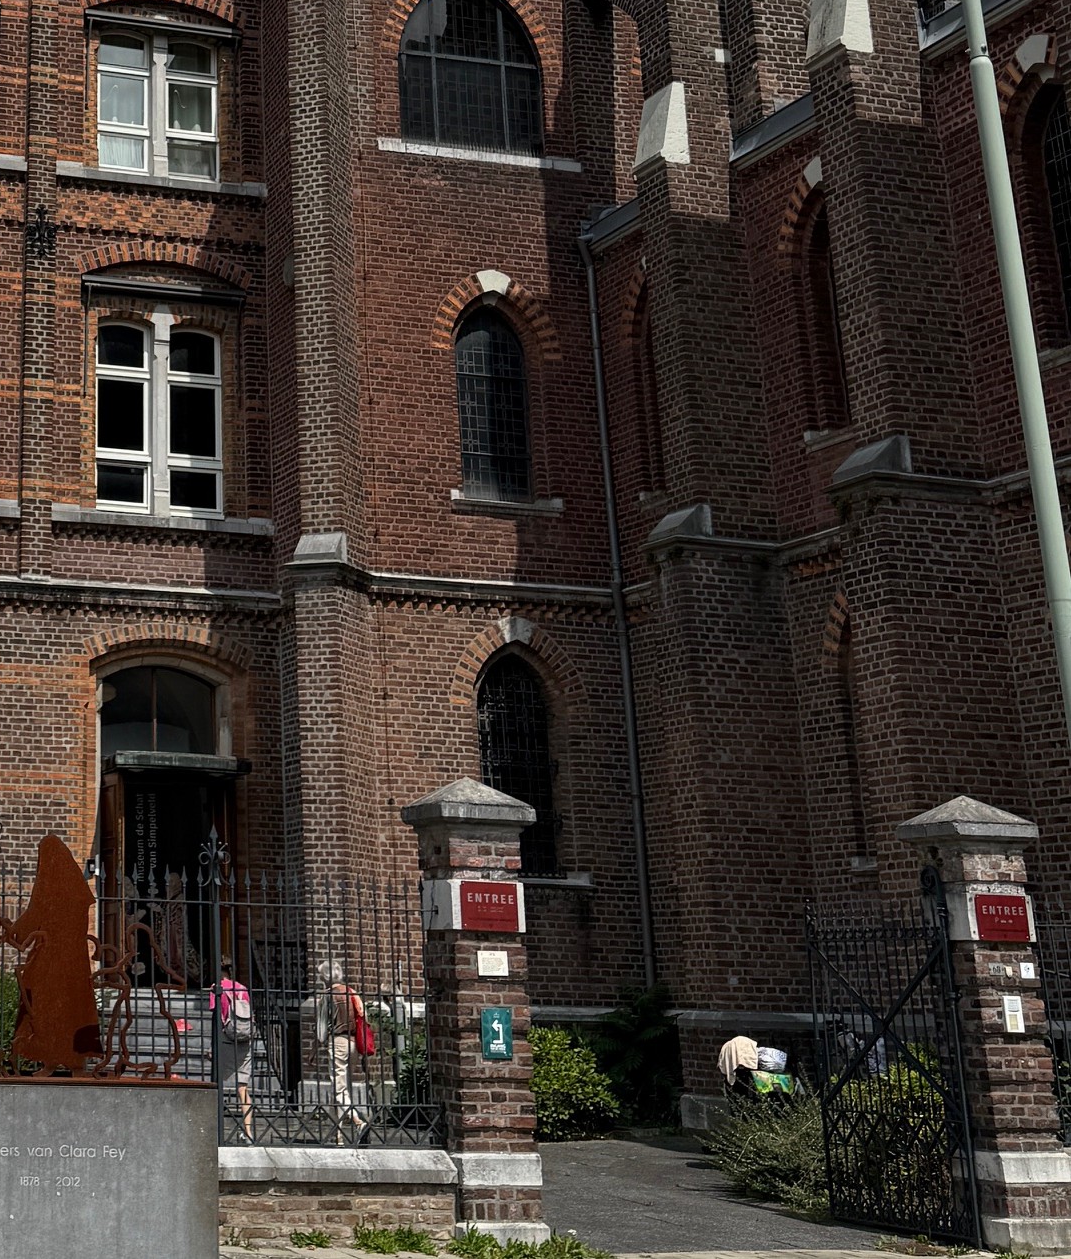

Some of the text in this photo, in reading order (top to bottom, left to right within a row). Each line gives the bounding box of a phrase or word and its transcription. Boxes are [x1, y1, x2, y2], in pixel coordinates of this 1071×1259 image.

[135, 794, 145, 882] museum de Schat
[147, 793, 159, 869] van Simpelveld
[467, 892, 515, 905] ENTREE
[982, 905, 1025, 916] ENTREE
[27, 1146, 53, 1157] van
[59, 1144, 96, 1158] Clara
[103, 1145, 126, 1161] Fey
[20, 1176, 40, 1187] 1878
[55, 1176, 81, 1187] 2012
